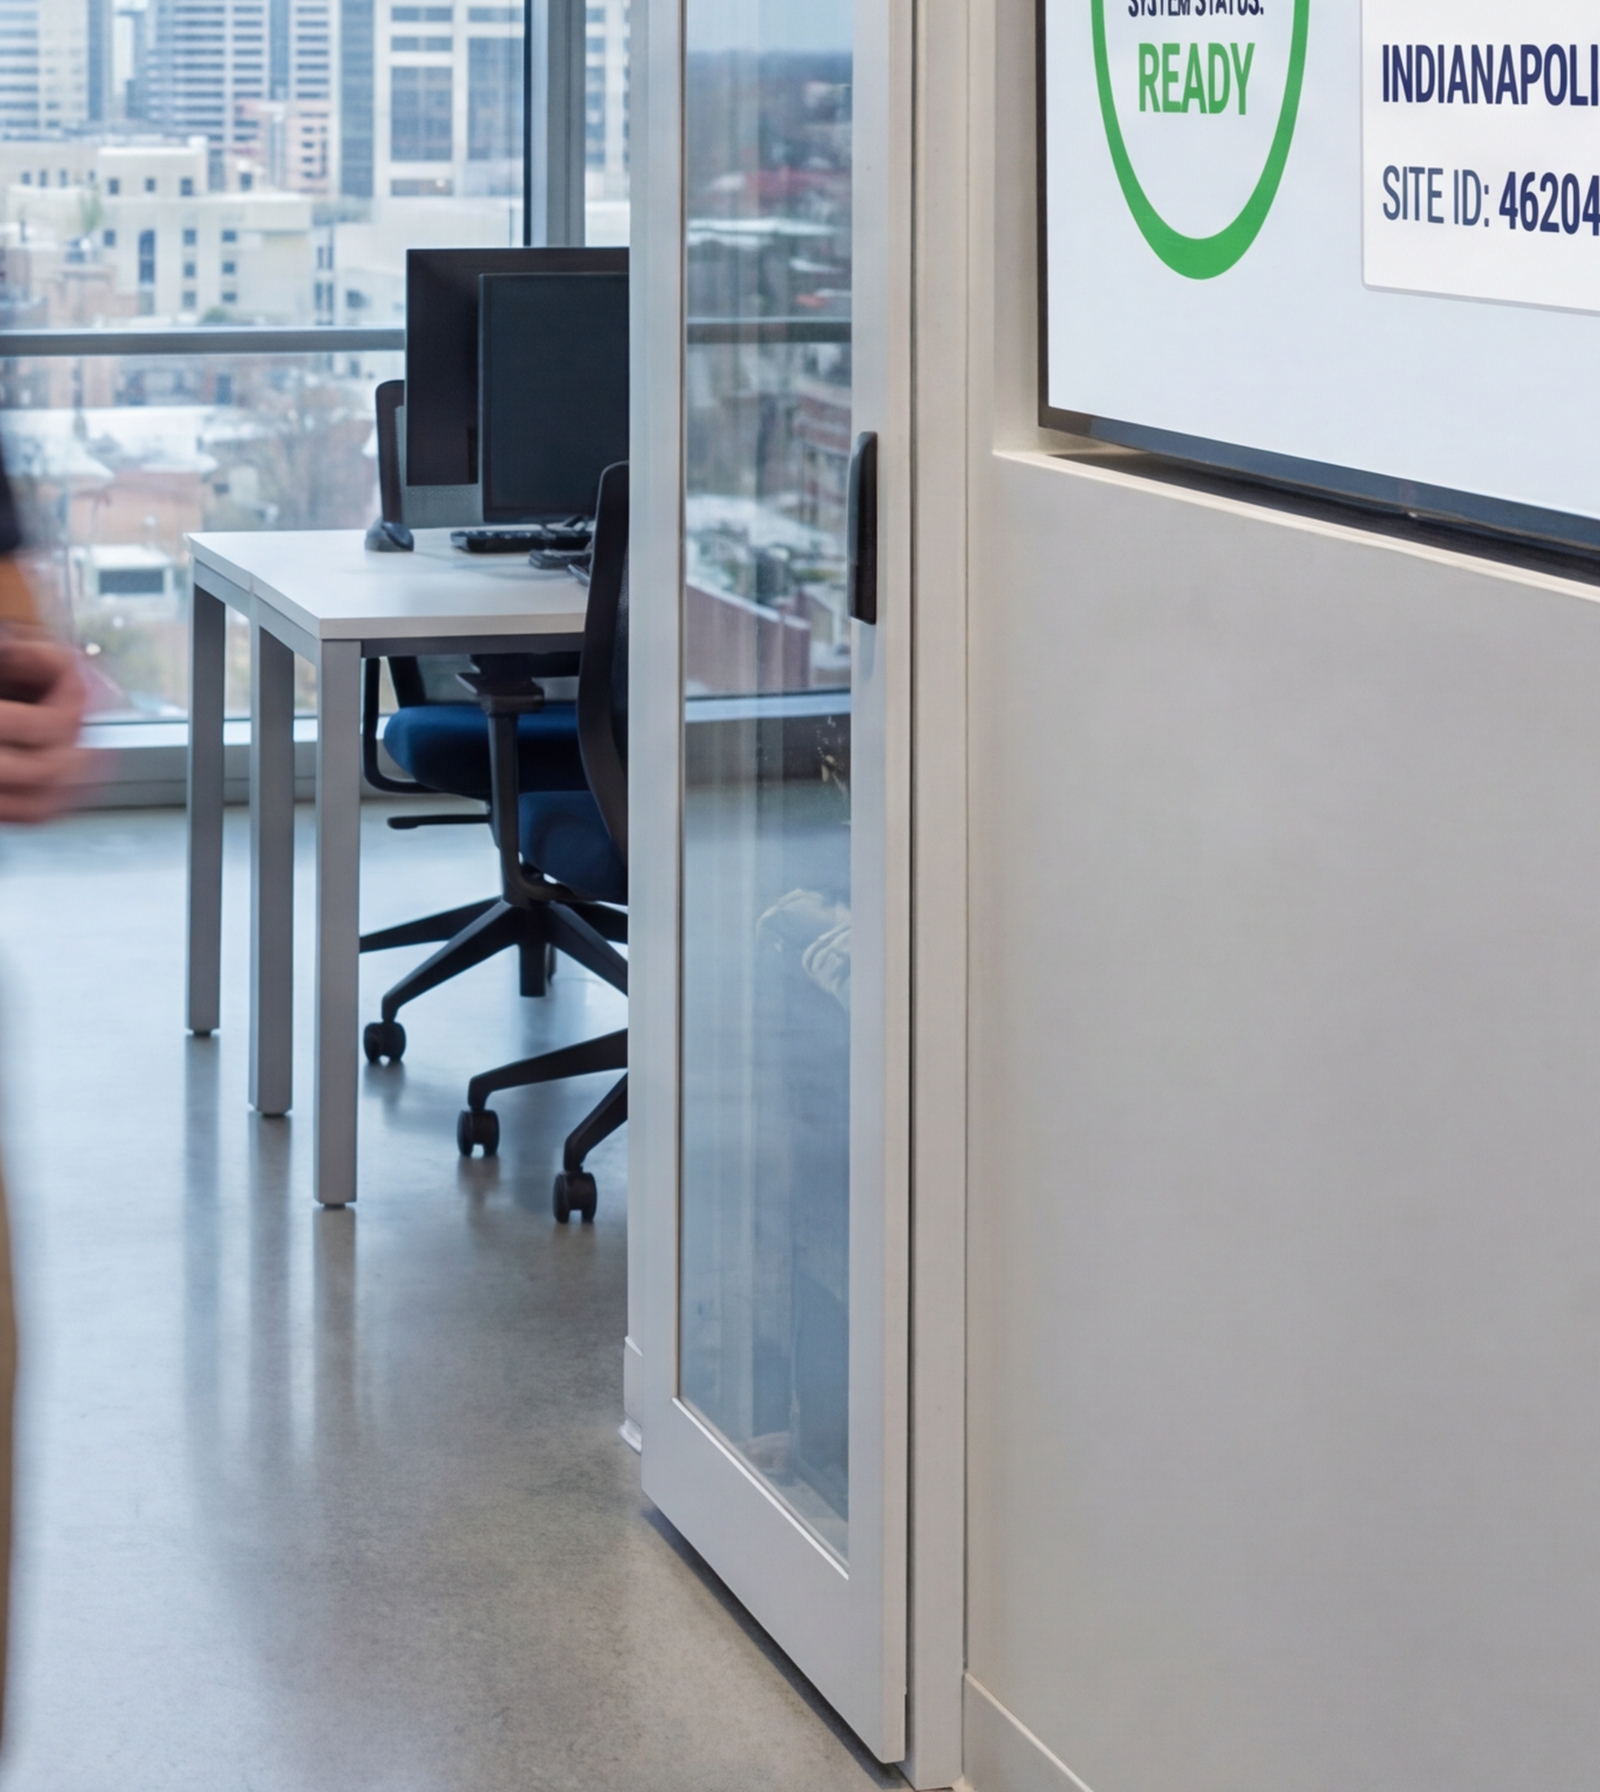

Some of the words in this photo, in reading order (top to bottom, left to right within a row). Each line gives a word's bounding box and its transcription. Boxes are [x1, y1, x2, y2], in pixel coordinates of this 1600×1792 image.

[1139, 43, 1255, 115] READY
[1383, 165, 1444, 224] SITE
[1454, 170, 1489, 227] ID:
